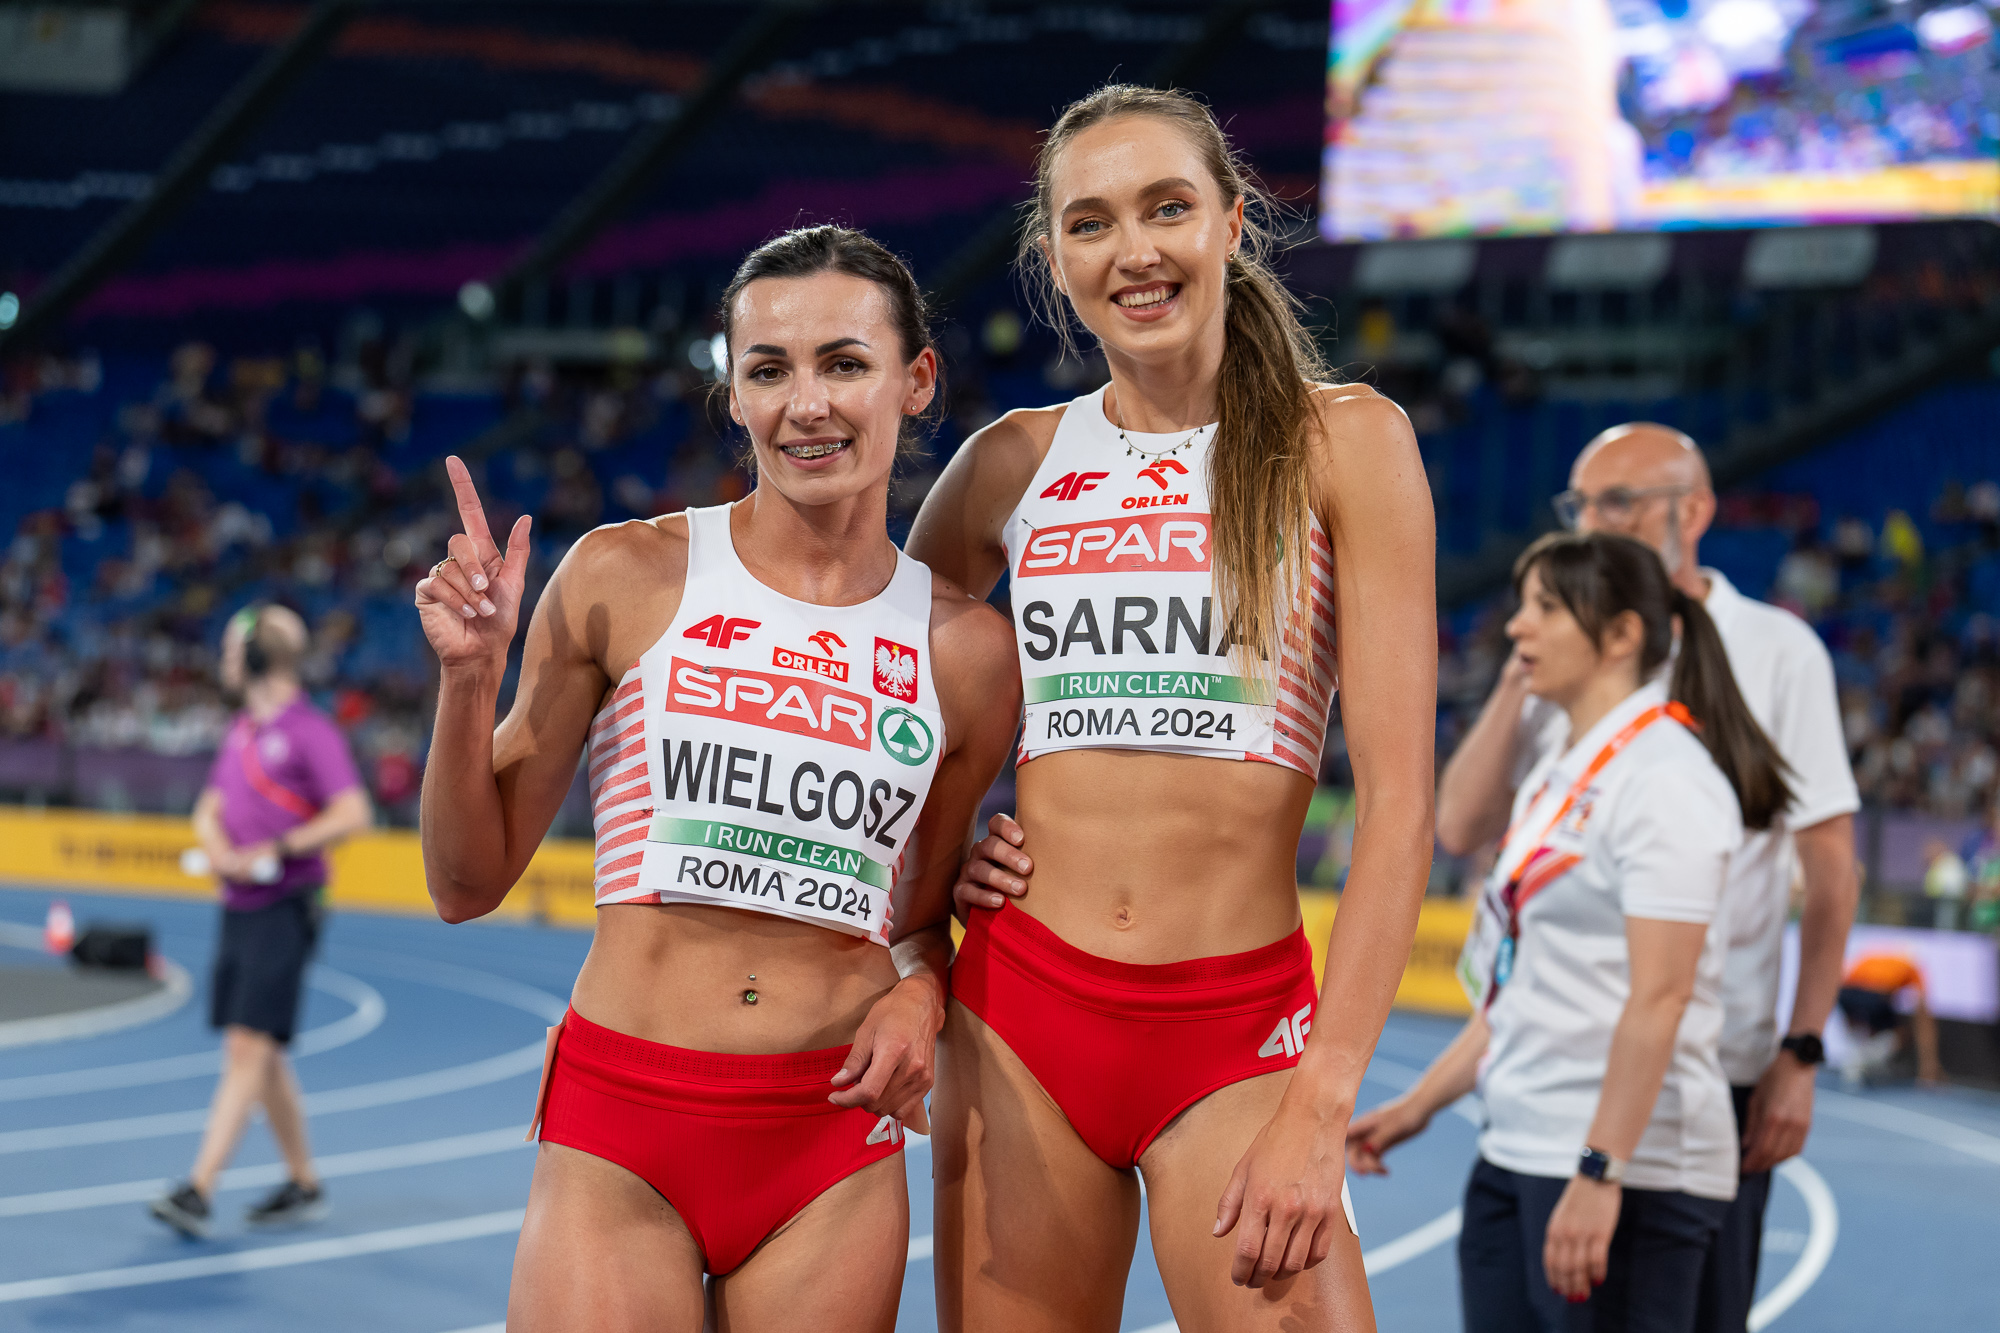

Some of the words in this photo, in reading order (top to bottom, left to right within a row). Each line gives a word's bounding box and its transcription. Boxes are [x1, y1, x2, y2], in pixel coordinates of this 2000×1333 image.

[1039, 471, 1111, 502] 4F
[1121, 493, 1189, 510] ORLEN
[1025, 520, 1208, 569] SPAR
[682, 614, 762, 650] 4F
[777, 651, 844, 679] ORLEN
[1060, 676, 1065, 696] I
[1069, 676, 1119, 696] RUN
[673, 666, 867, 741] SPAR
[1047, 708, 1142, 739] ROMA
[1150, 708, 1236, 741] 2024
[662, 738, 916, 850] WIELGOSZ
[704, 824, 712, 843] I
[717, 826, 773, 855] RUN
[677, 856, 785, 902] ROMA
[795, 877, 872, 921] 2024
[1257, 1002, 1311, 1058] 4F
[865, 1114, 903, 1146] 4
